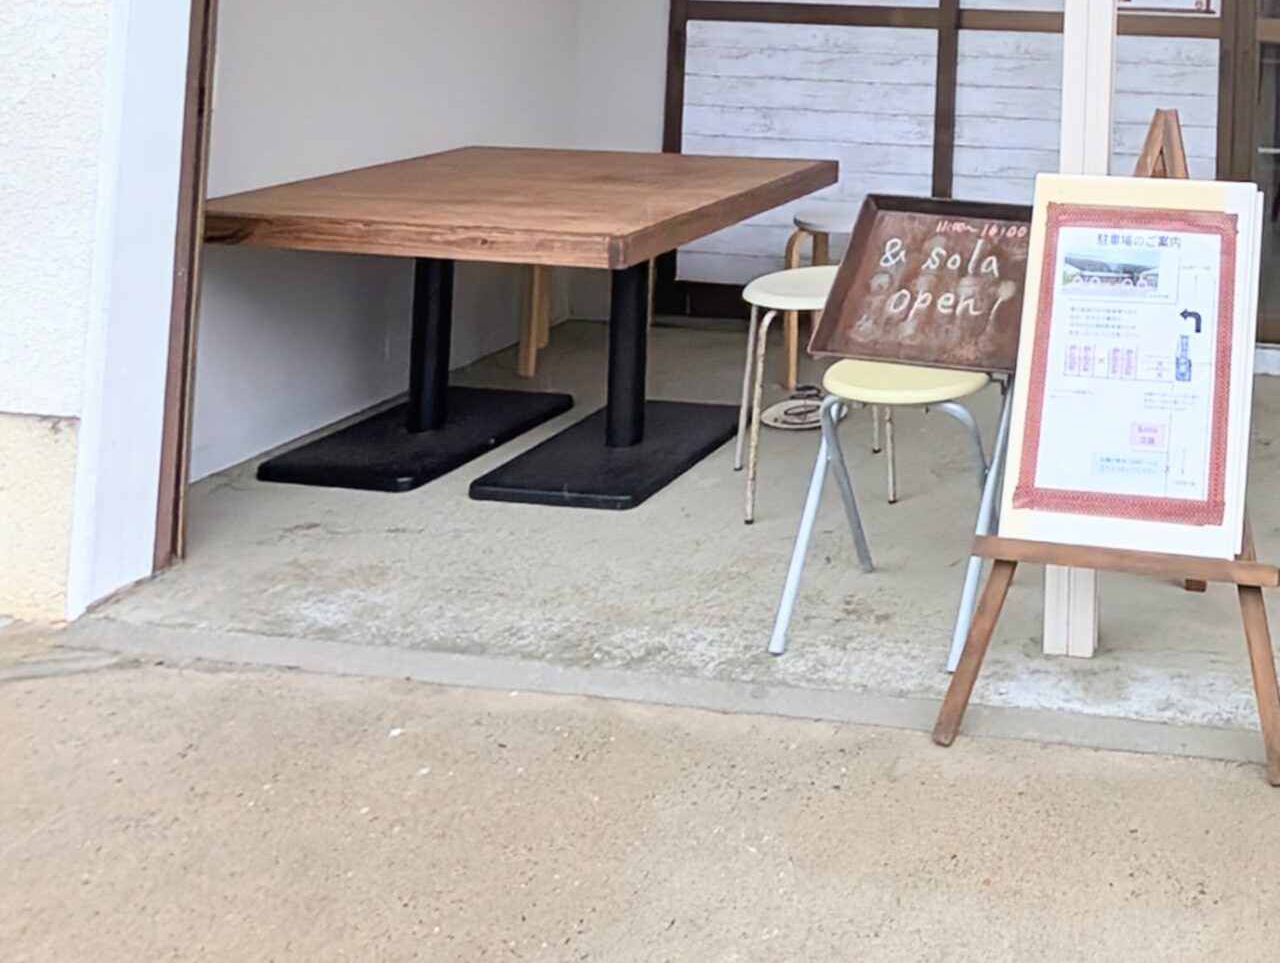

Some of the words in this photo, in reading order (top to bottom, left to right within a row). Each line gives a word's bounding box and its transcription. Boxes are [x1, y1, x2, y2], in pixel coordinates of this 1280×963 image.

[1097, 233, 1182, 249] 駐車場のご案内
[879, 237, 907, 268] &
[921, 239, 999, 278] sola
